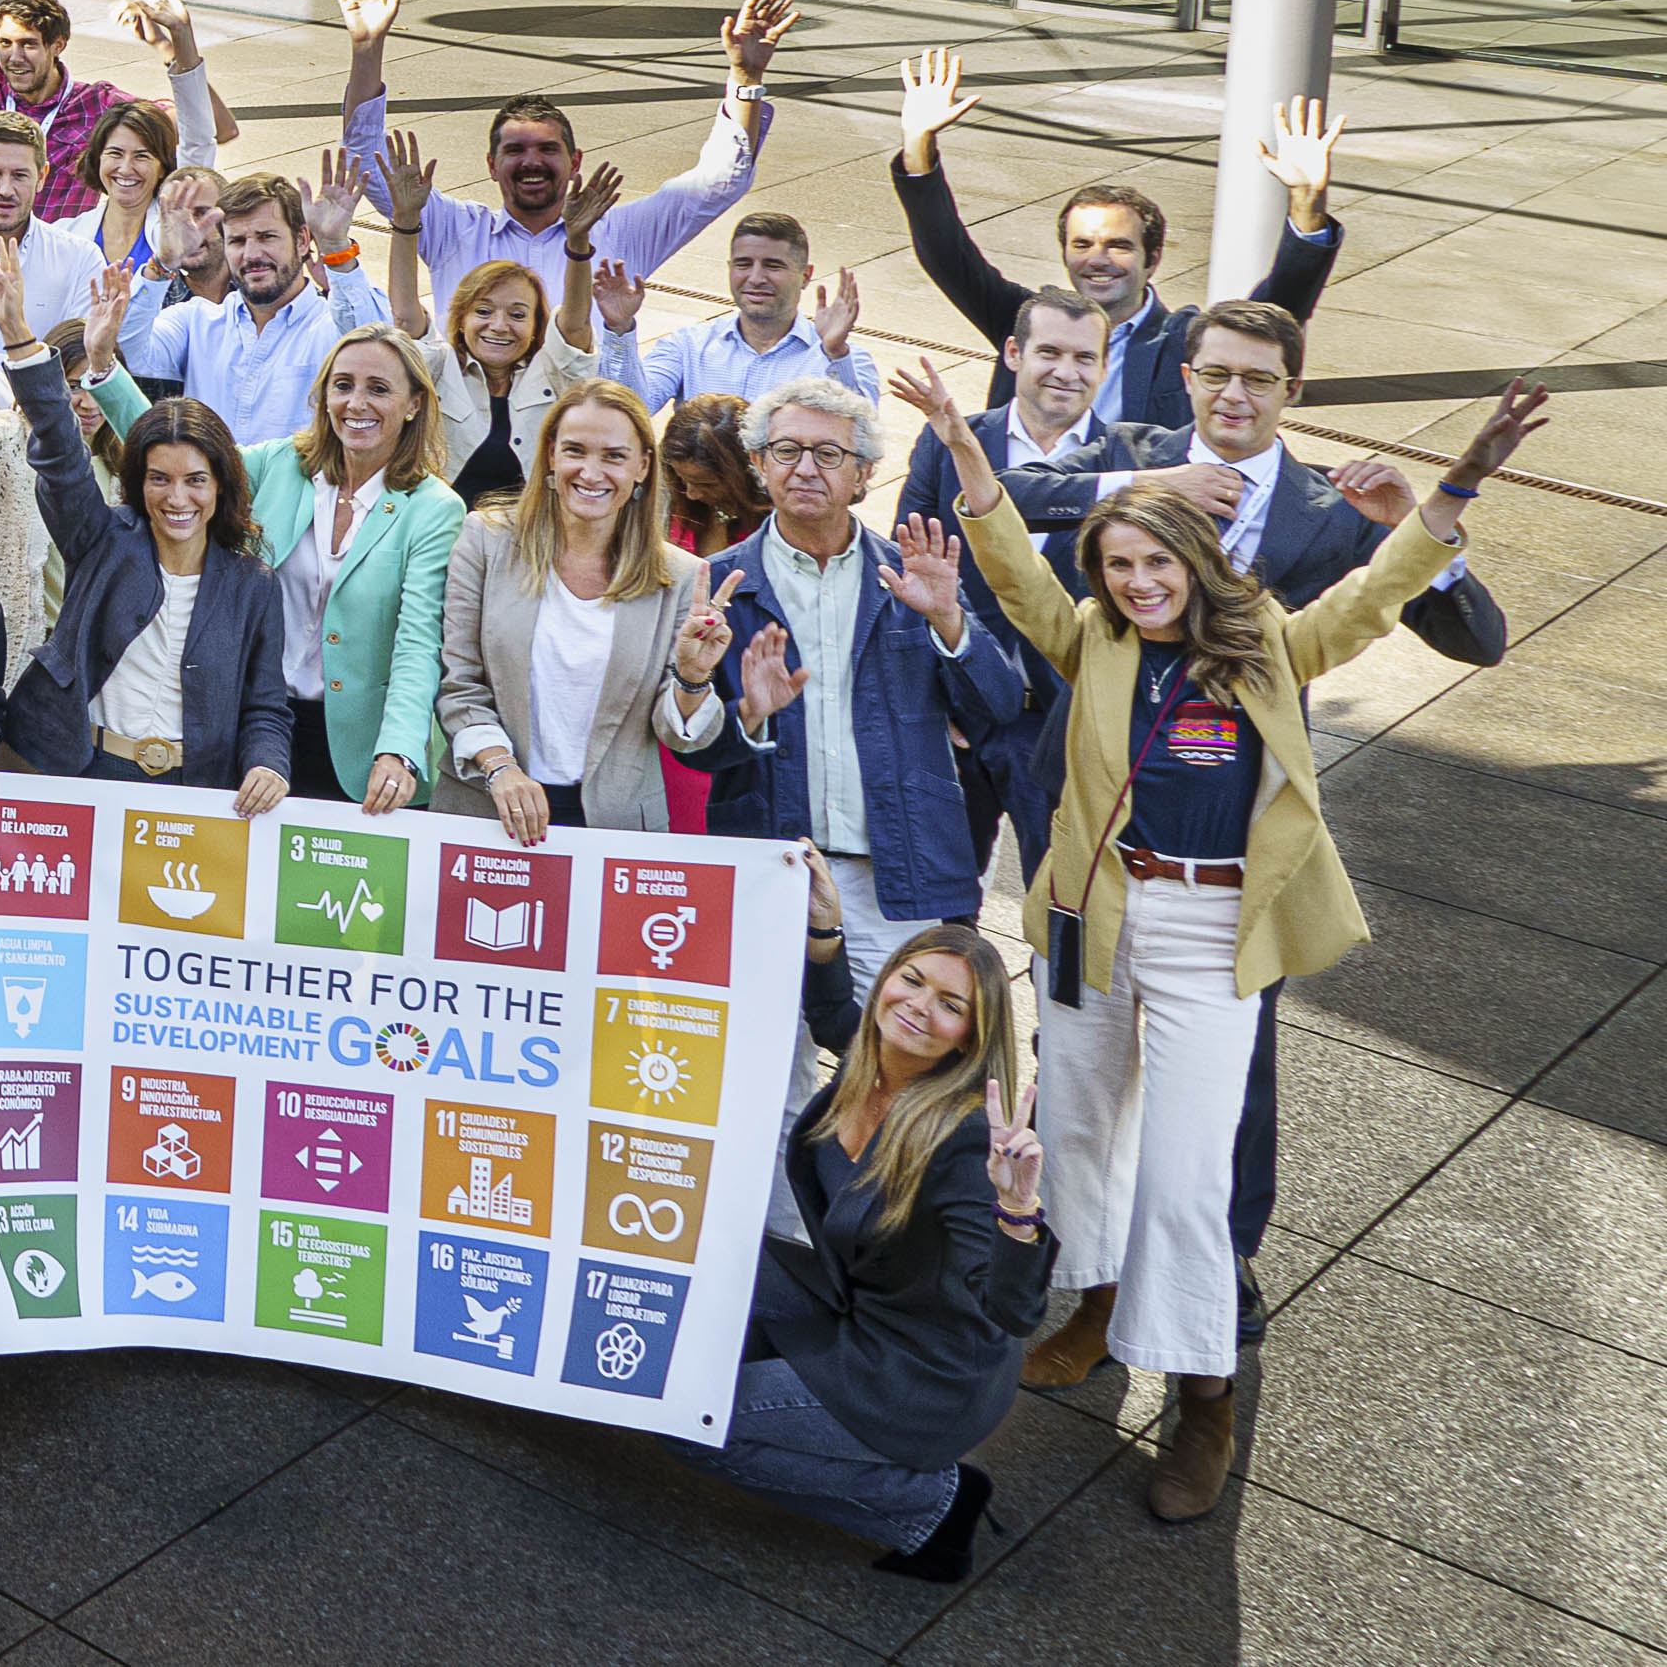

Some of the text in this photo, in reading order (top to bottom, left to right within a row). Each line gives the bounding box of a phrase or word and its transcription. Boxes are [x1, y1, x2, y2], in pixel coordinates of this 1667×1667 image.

[1, 806, 17, 819] FIN
[1, 821, 69, 838] DE LA POBREZA
[133, 819, 149, 845] 2
[156, 821, 195, 836] HAMBRE
[155, 834, 181, 849] CERO
[290, 834, 306, 862] 3
[311, 836, 342, 852] SALUD
[311, 851, 369, 870] Y BIENESTAR
[450, 853, 468, 882] 4
[474, 855, 531, 872] EDUCACIÓN
[473, 870, 531, 887] DE CALIDAD
[613, 867, 630, 894] 5
[636, 868, 686, 883] IGUALDAD
[636, 882, 649, 895] DE
[23, 938, 53, 952] LIMPIA
[5, 952, 66, 967] SANEAMIENTO
[117, 944, 563, 1026] TOGETHER FOR THE
[114, 993, 322, 1034] SUSTAINABLE
[606, 996, 620, 1023] 7
[627, 1013, 634, 1025] Y
[634, 1014, 649, 1028] NO
[113, 1021, 321, 1062] DEVELOPMENT
[328, 1015, 560, 1087] GOALS
[33, 1070, 72, 1084] DECENTE
[140, 1077, 190, 1093] INDUSTRIA,
[1, 1084, 56, 1097] CRECIMIENTO
[121, 1075, 136, 1102] 9
[140, 1090, 200, 1107] INNOVACIÓN E
[139, 1102, 222, 1123] INFRAESTRUCTURA
[276, 1090, 301, 1117] 10
[305, 1093, 388, 1114] REDUCCIÓN DE LAS
[304, 1107, 378, 1127] DESIGUALDADES
[436, 1109, 456, 1137] 11
[460, 1112, 516, 1130] CIUDADES Y
[459, 1126, 529, 1147] COMUNIDADES
[458, 1139, 523, 1160] SOSTENIBLES
[600, 1132, 625, 1164] 12
[629, 1151, 637, 1165] Y
[116, 1205, 139, 1232] 14
[146, 1207, 169, 1221] VIDA
[33, 1218, 56, 1232] CLIMA
[146, 1221, 199, 1238] SUBMARINA
[270, 1220, 294, 1248] 15
[298, 1223, 320, 1237] VIDA
[297, 1236, 371, 1259] DE ECOSISTEMAS
[429, 1242, 455, 1271] 16
[297, 1249, 352, 1269] TERRESTRES
[461, 1247, 523, 1270] PAZ, JUSTICIA
[460, 1274, 499, 1294] SÓLIDAS
[461, 1261, 533, 1287] E INSTITUCIONES
[587, 1269, 608, 1299] 17
[609, 1274, 674, 1298] ALIANZAS PARA
